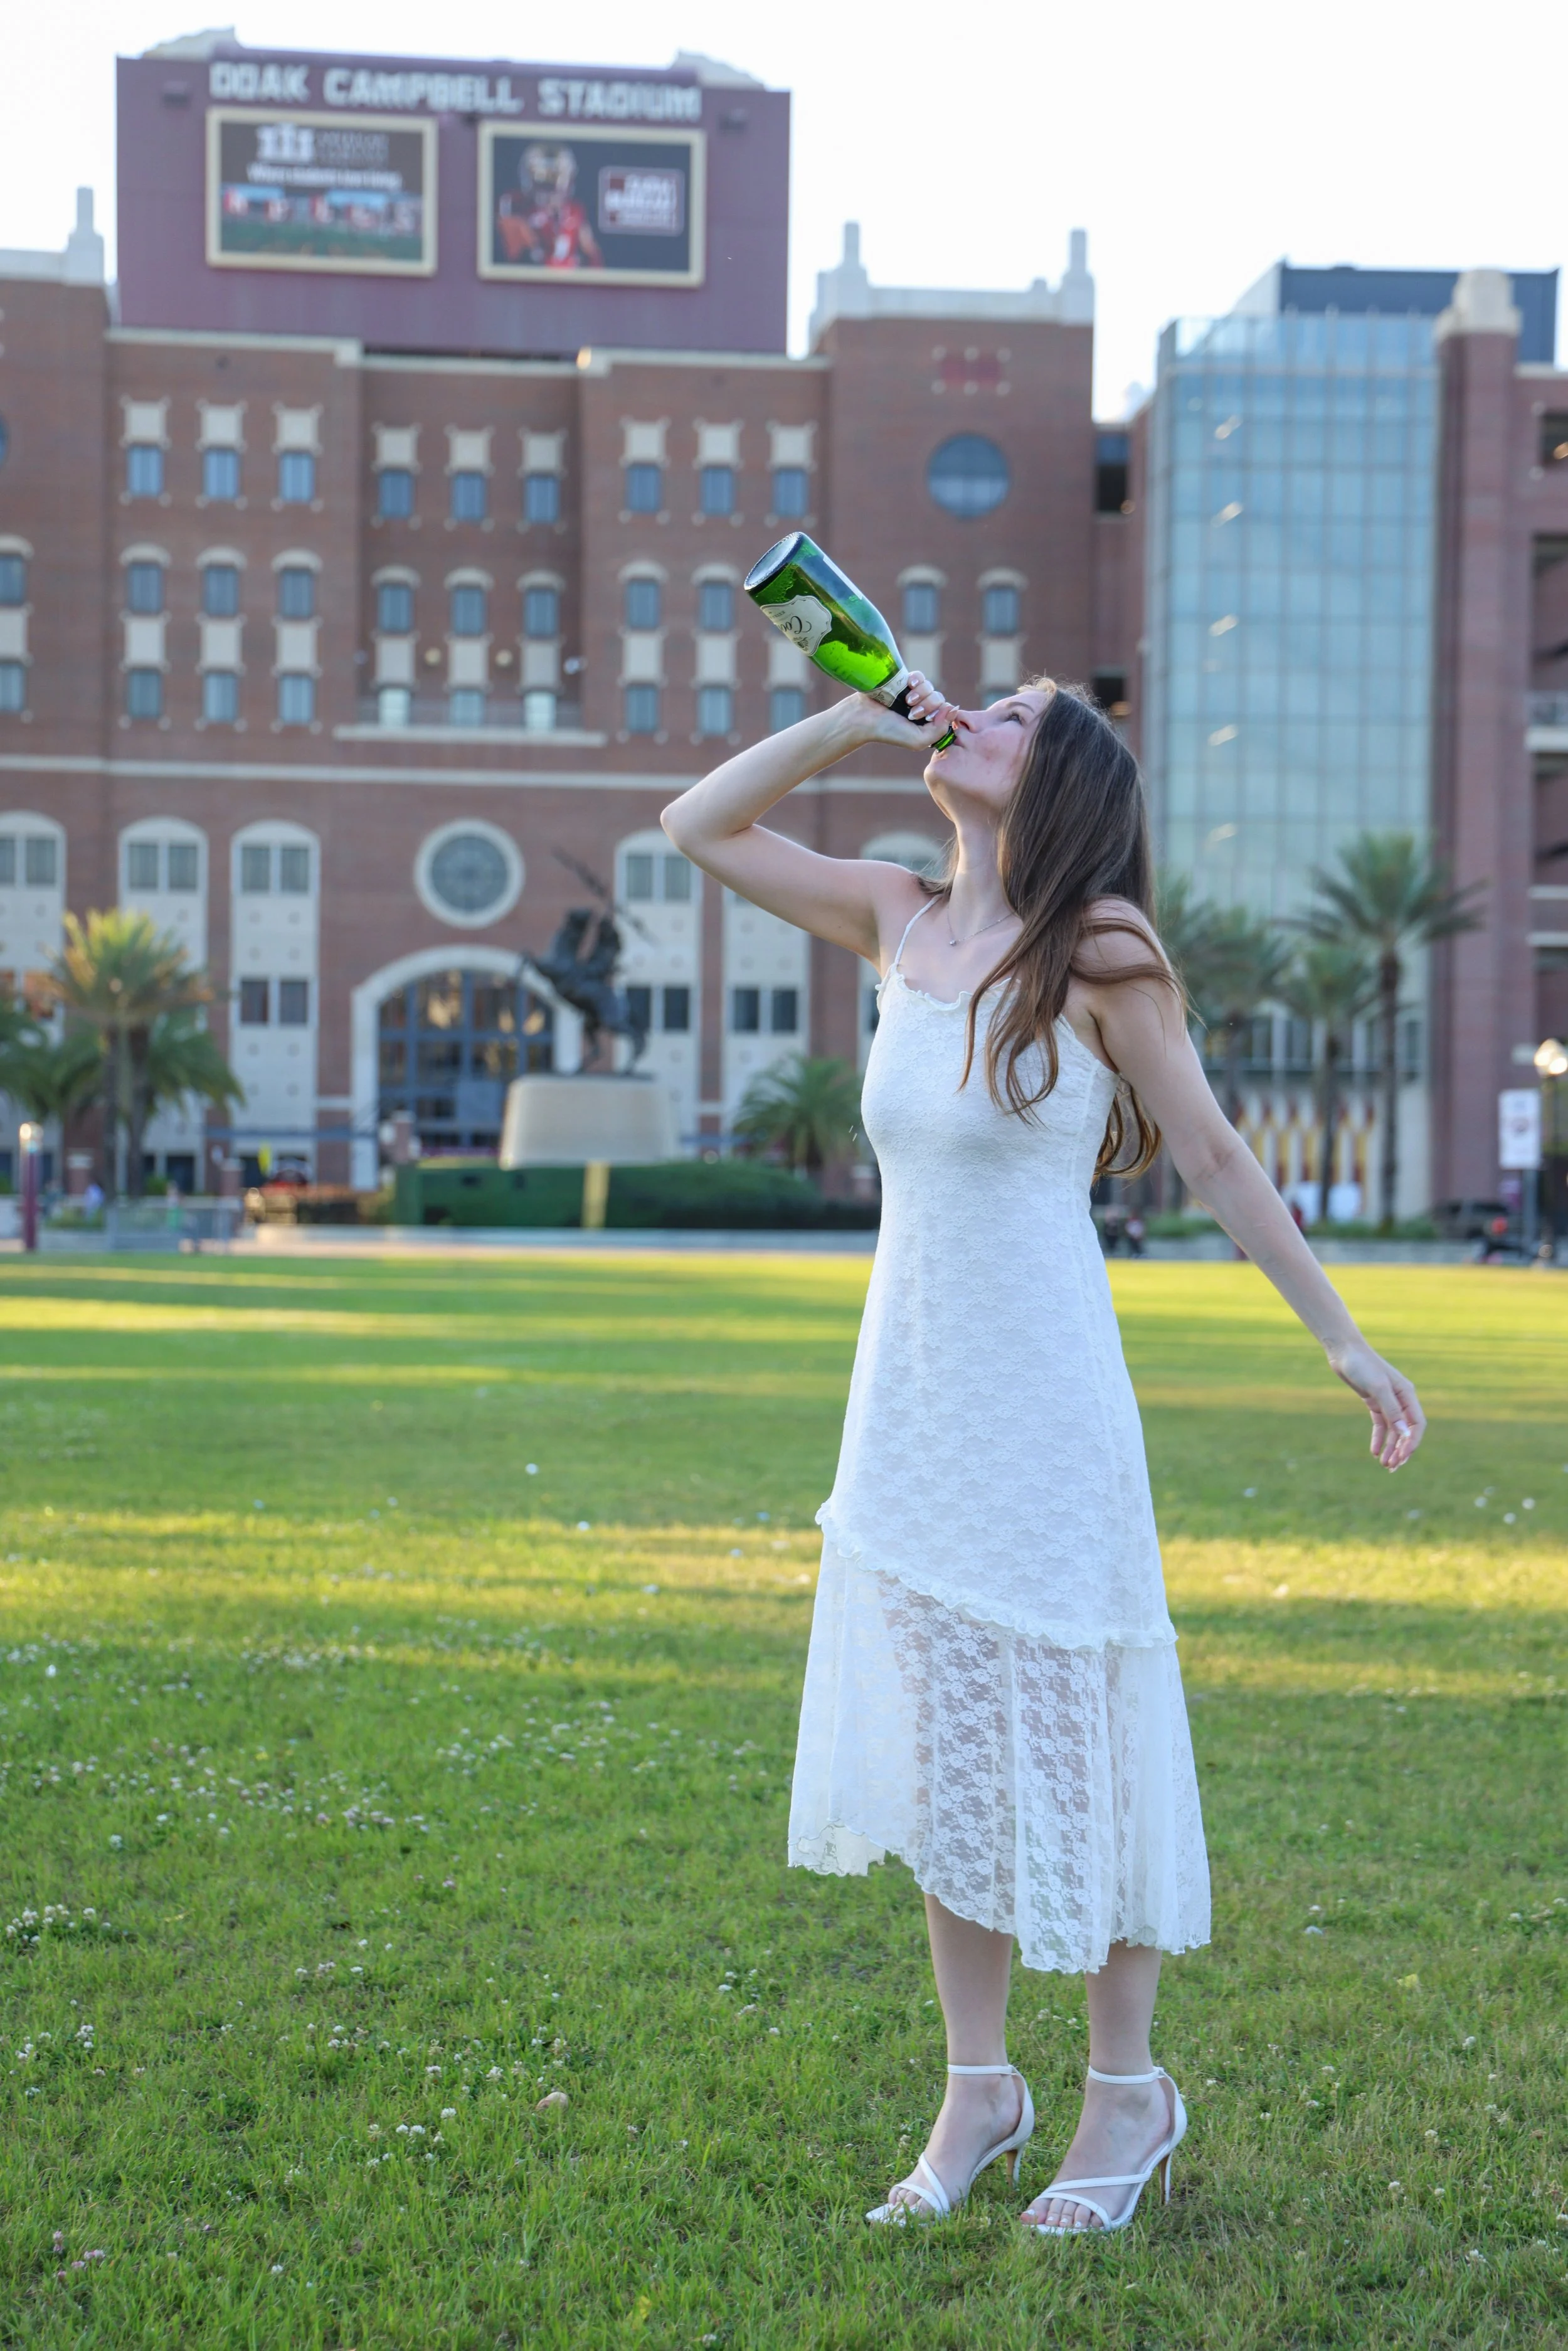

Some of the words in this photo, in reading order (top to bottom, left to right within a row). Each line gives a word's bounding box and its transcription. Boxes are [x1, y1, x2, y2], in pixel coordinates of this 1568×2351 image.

[210, 61, 309, 102] DOAK
[324, 67, 523, 114] CAMPBELL
[538, 77, 701, 122] STADIUM
